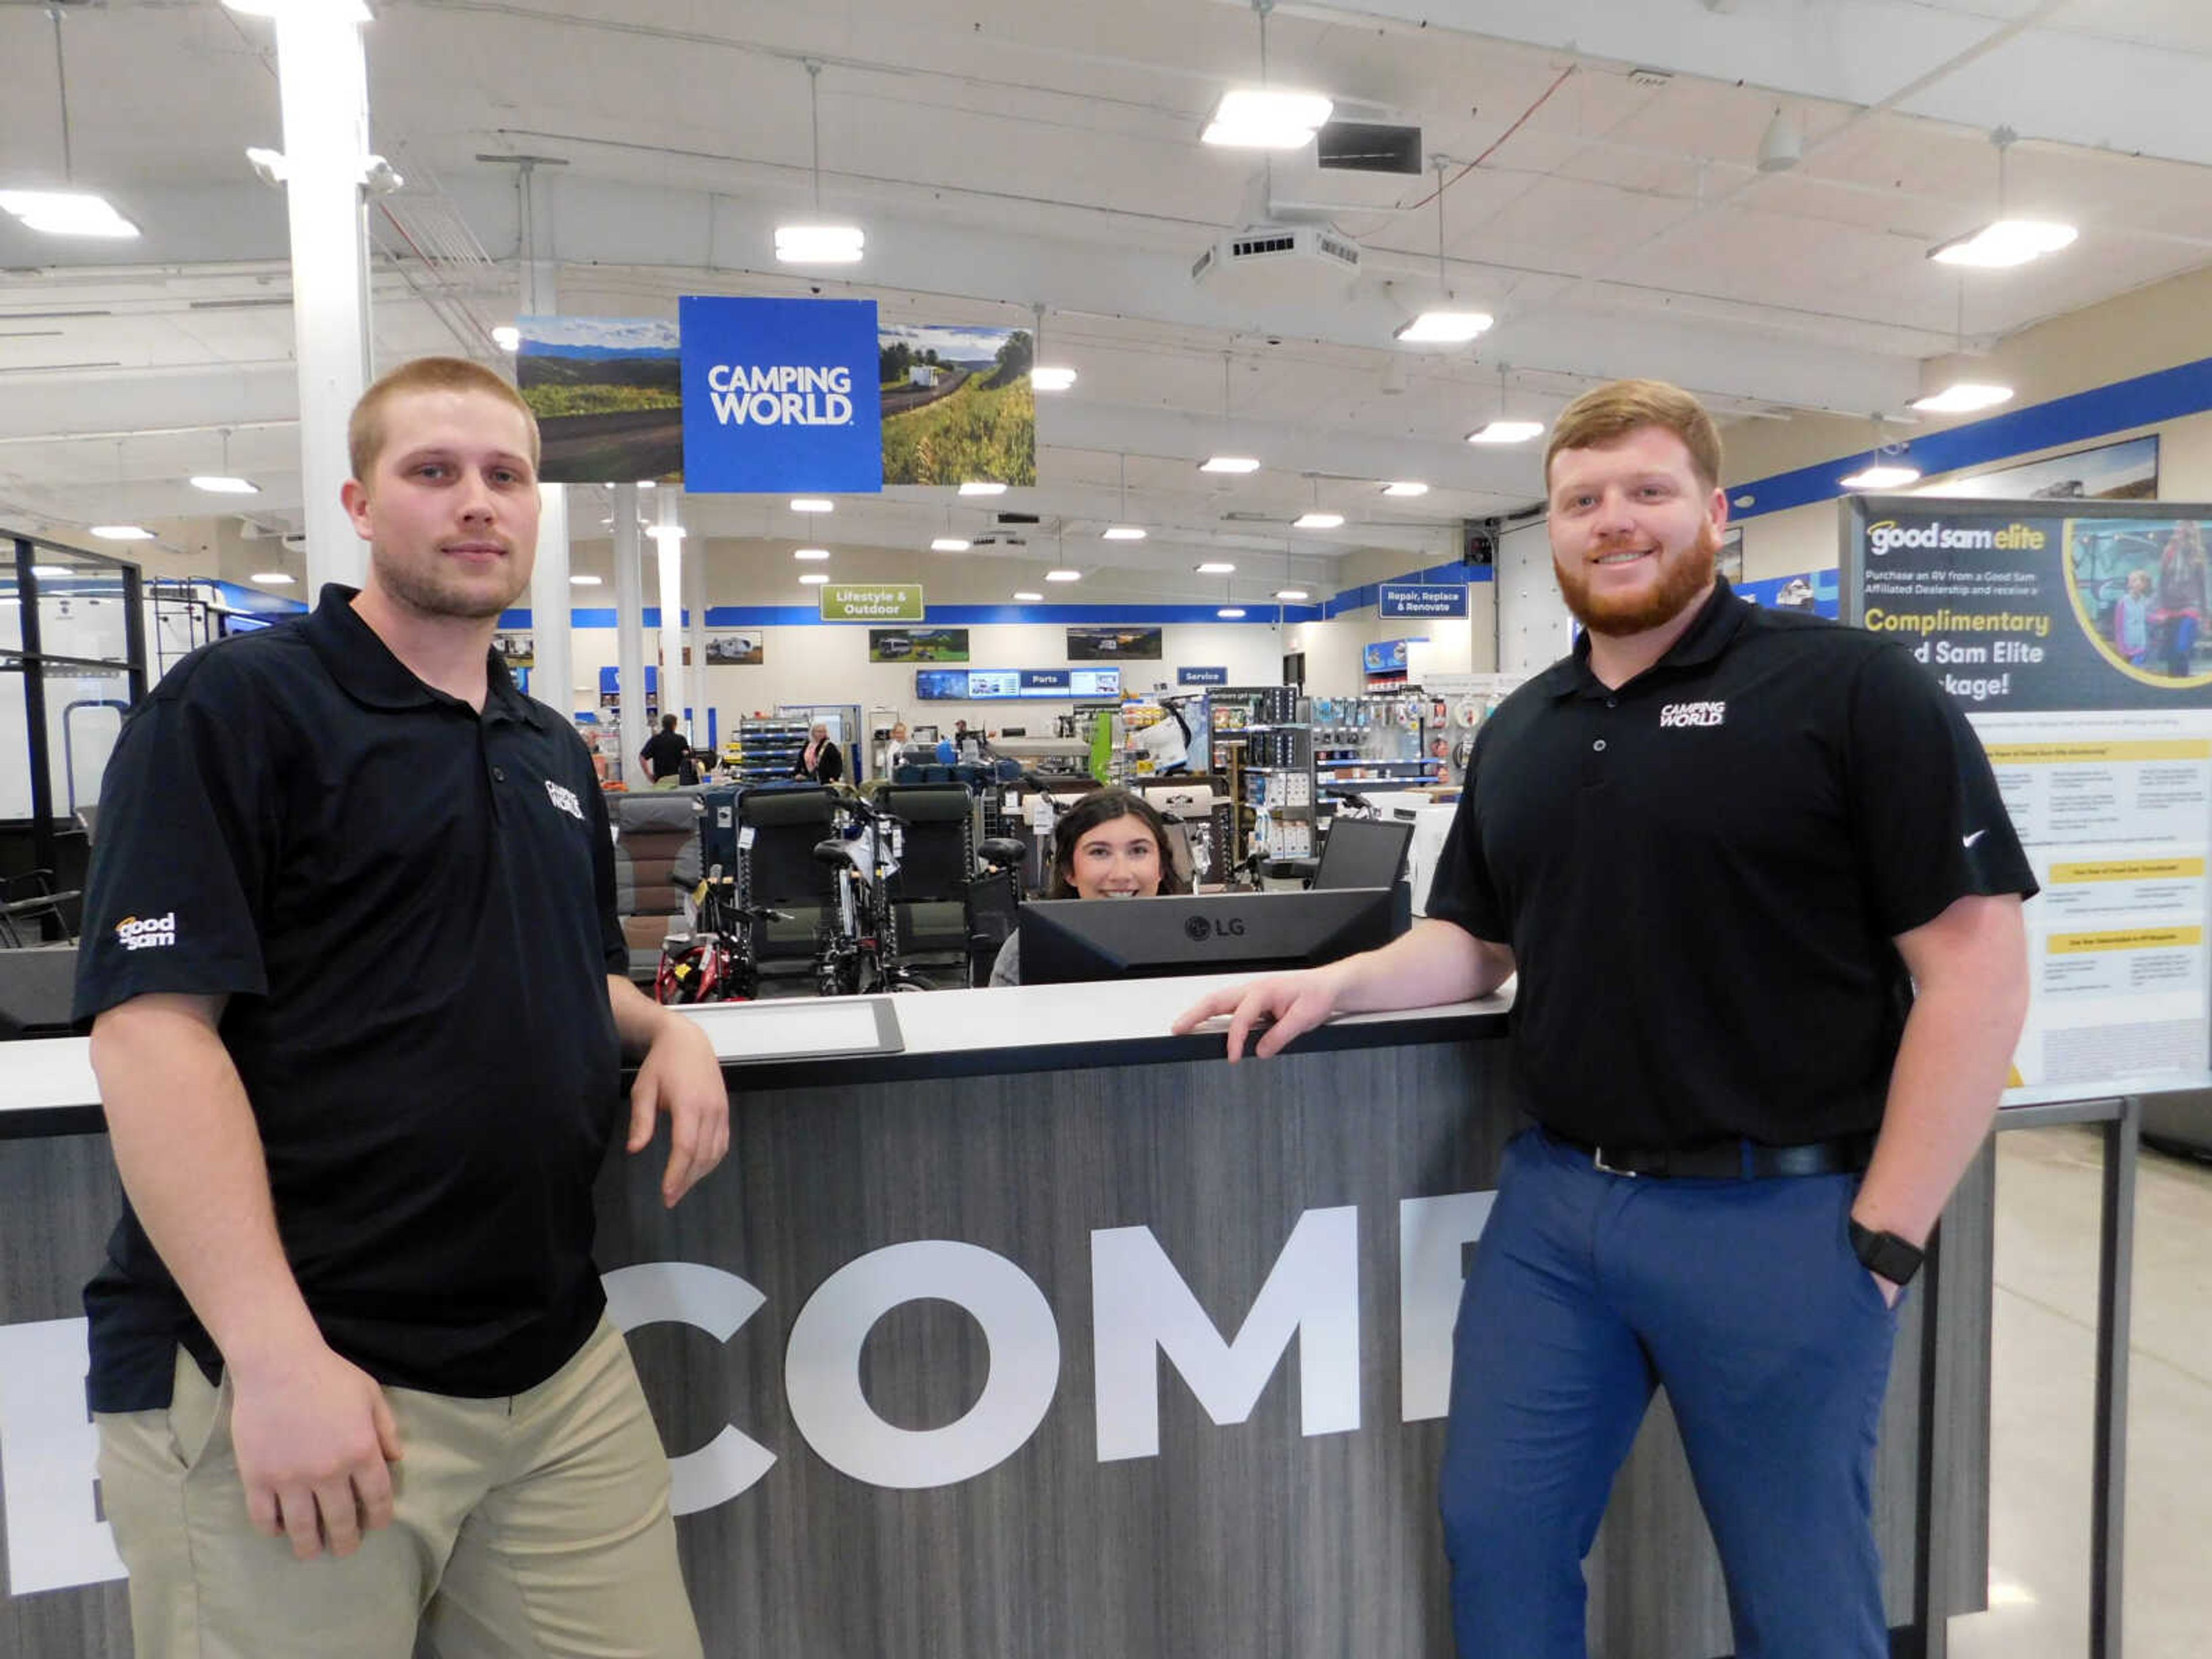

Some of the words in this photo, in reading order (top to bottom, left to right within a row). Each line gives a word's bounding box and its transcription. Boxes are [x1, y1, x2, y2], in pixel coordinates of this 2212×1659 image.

[708, 365, 851, 393] CAMPING
[710, 392, 853, 425] WORLD
[1870, 522, 1939, 555] good
[1940, 529, 1991, 548] sam
[1994, 524, 2044, 549] elite
[1865, 570, 1913, 580] Purchase
[1915, 573, 1930, 581] an
[1931, 571, 1945, 581] RV
[1948, 571, 1972, 581] from
[1983, 571, 2011, 581] Good
[2013, 572, 2036, 582] Sam
[1388, 591, 1421, 602] Repair,
[1422, 592, 1459, 601] Replace
[1864, 584, 1913, 594] Affiliated
[1914, 584, 1970, 596] Dealership
[1970, 585, 1991, 595] and
[836, 591, 893, 604] Lifestyle
[897, 592, 907, 602] &
[844, 604, 900, 614] Outdoor
[1406, 603, 1450, 611] Renovate
[1865, 608, 2050, 637] Complimentary
[1936, 641, 1986, 663] Sam
[1993, 641, 2044, 663] Elite
[1032, 675, 1058, 684] Parts
[1186, 672, 1219, 680] Service
[1939, 673, 2010, 701] kage!
[1661, 702, 1726, 715] CAMPING
[1660, 713, 1723, 727] WORLD
[119, 912, 175, 944] good
[1216, 918, 1244, 936] LG
[126, 932, 175, 950] sam
